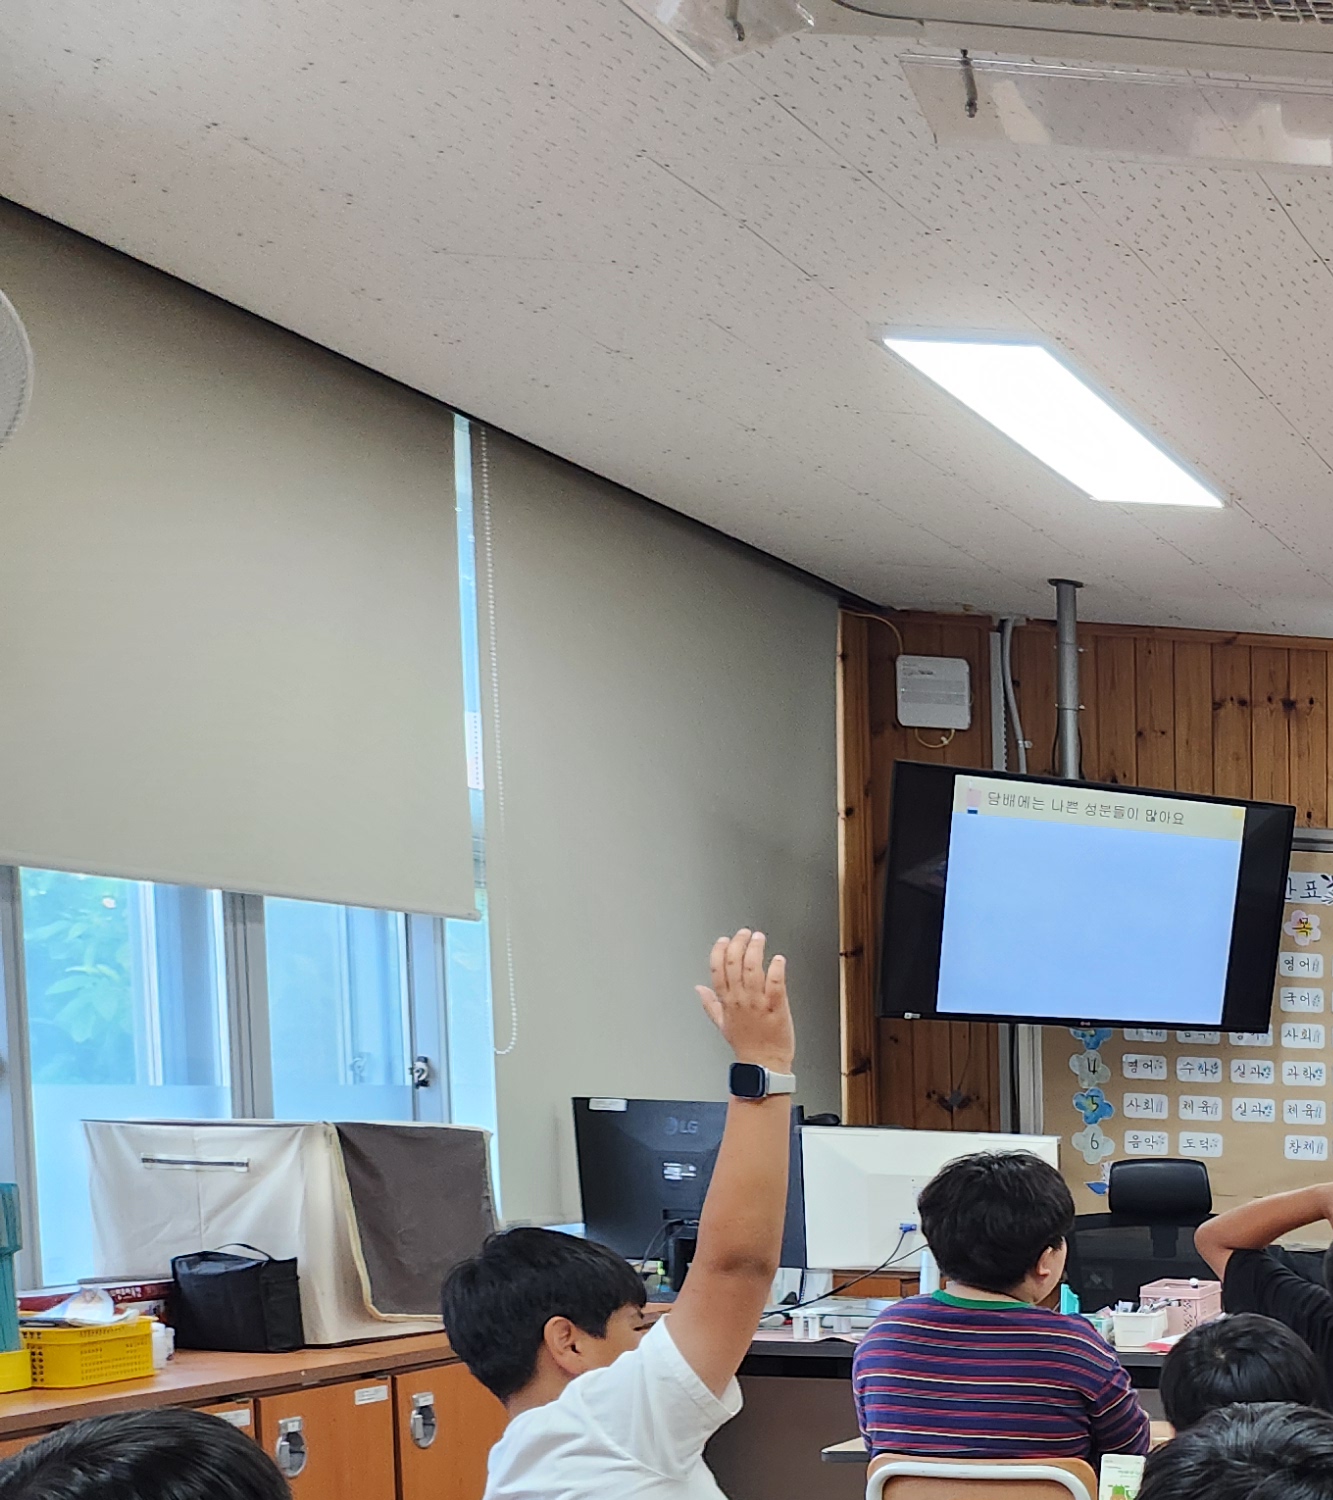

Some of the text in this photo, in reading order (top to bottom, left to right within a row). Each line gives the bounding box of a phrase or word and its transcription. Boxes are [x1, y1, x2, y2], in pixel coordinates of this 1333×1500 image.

[987, 791, 1185, 826] 담배에는 나쁜 성분들이 많아요
[1292, 917, 1313, 938] 목
[1284, 956, 1310, 972] 영어
[1283, 991, 1310, 1009] 국어
[1127, 1060, 1154, 1072] 영어
[1233, 1063, 1262, 1077] 실과
[1285, 1065, 1314, 1079] 과학
[1126, 1099, 1155, 1114] 사회
[1181, 1100, 1211, 1116] 체육
[1234, 1101, 1263, 1117] 실과
[1286, 1104, 1316, 1118] 체육
[680, 1120, 699, 1133] LG
[1090, 1135, 1099, 1150] 6
[1128, 1136, 1157, 1150] 음악
[1182, 1137, 1210, 1151] 도덕
